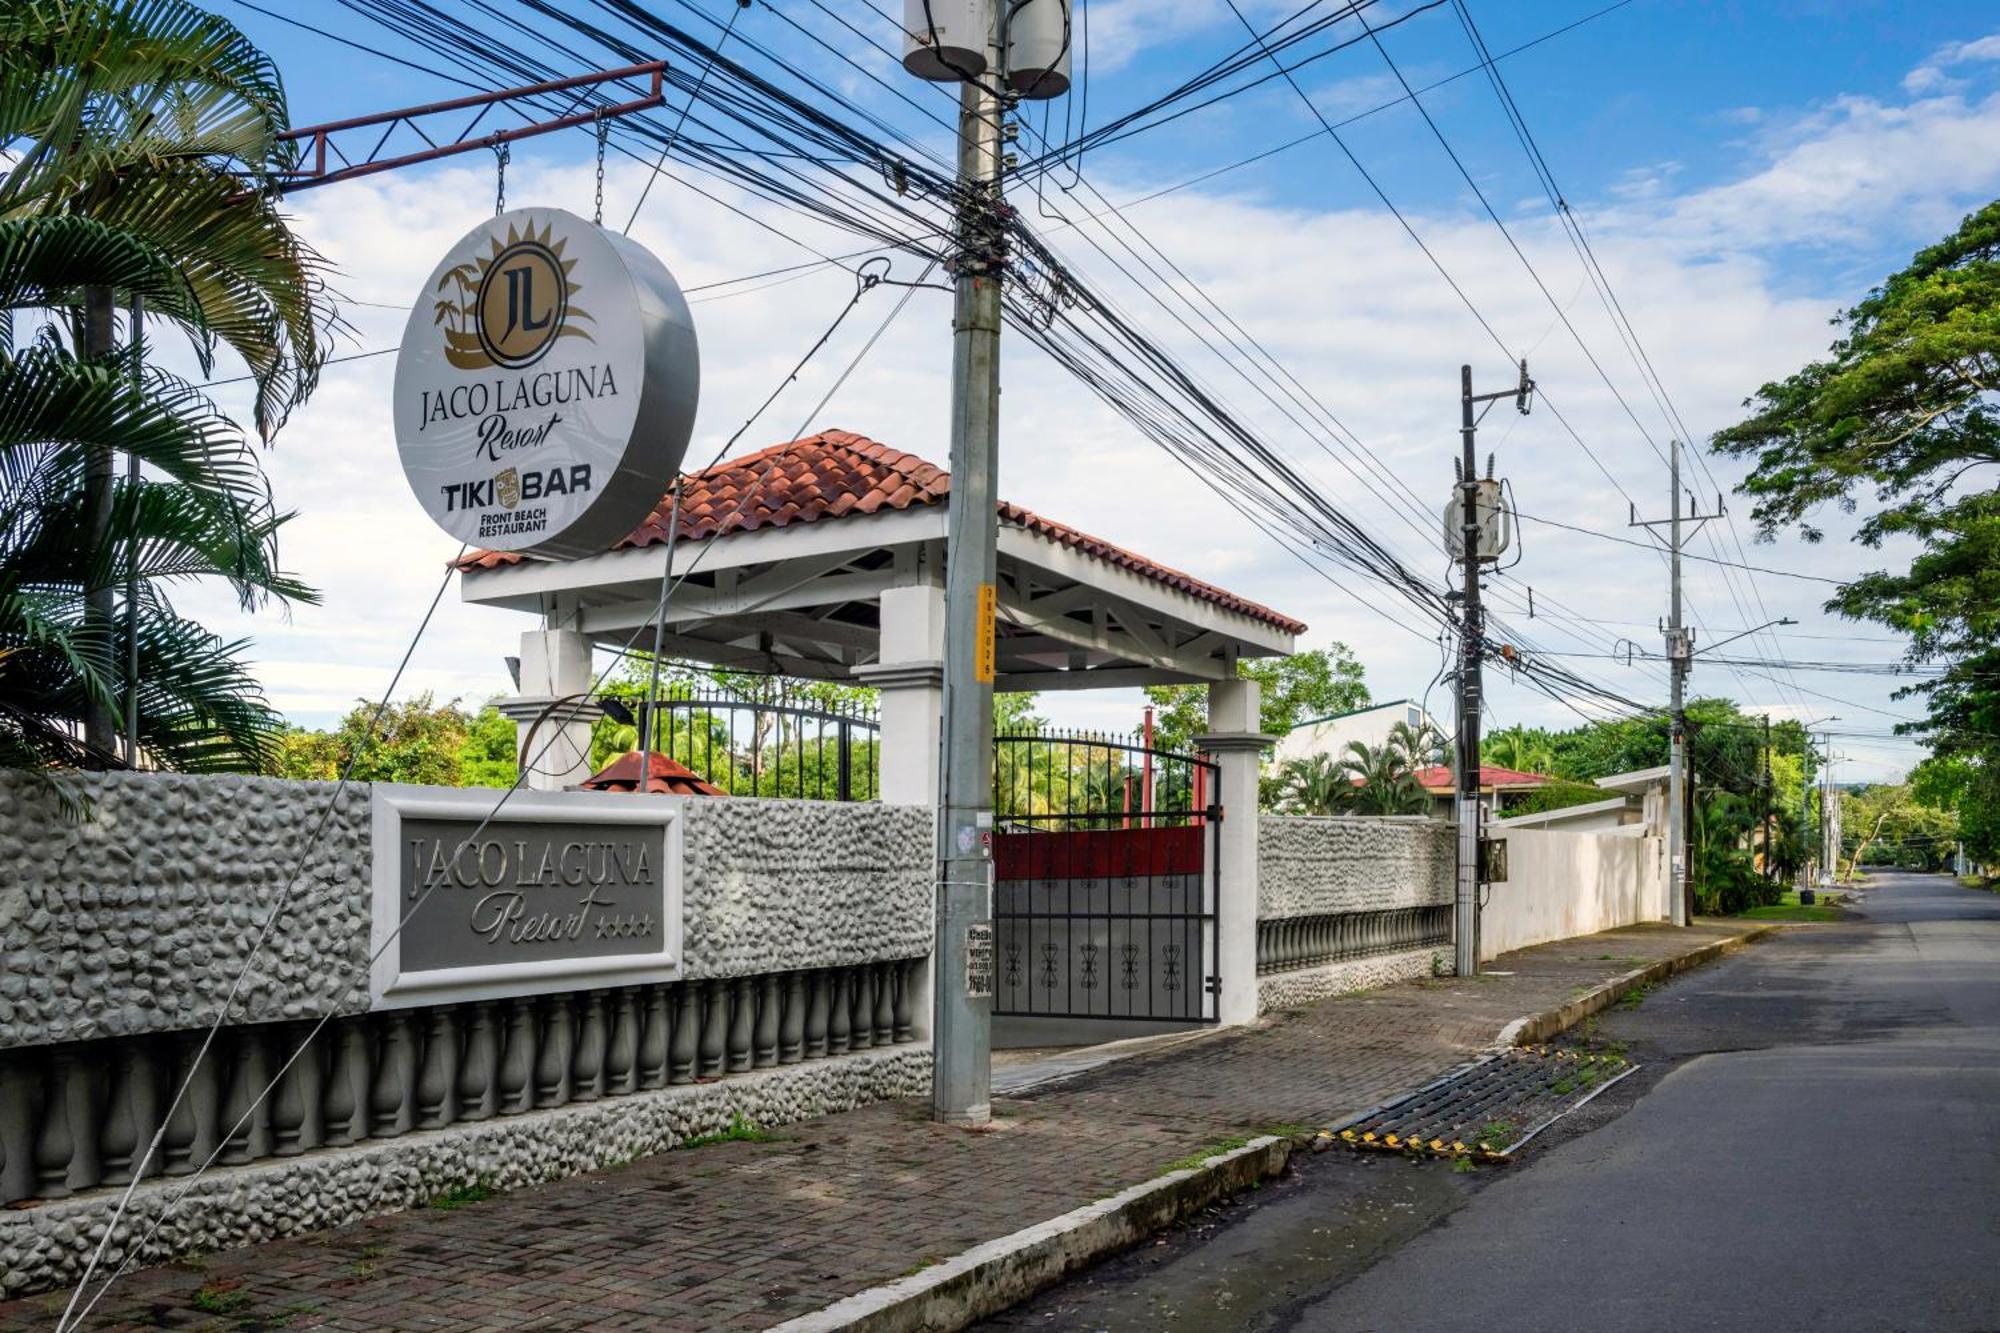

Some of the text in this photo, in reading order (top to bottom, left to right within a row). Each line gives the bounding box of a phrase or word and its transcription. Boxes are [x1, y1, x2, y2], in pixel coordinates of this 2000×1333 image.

[500, 266, 552, 345] JL
[419, 364, 619, 431] JACO LAGUNA
[475, 412, 562, 462] Resort
[441, 463, 592, 512] TIKI BAR
[479, 520, 547, 538] RESTAURANT
[481, 508, 546, 526] FRONT BEACH
[408, 839, 654, 900] JACO LAGUNA
[471, 885, 616, 944] Resort
